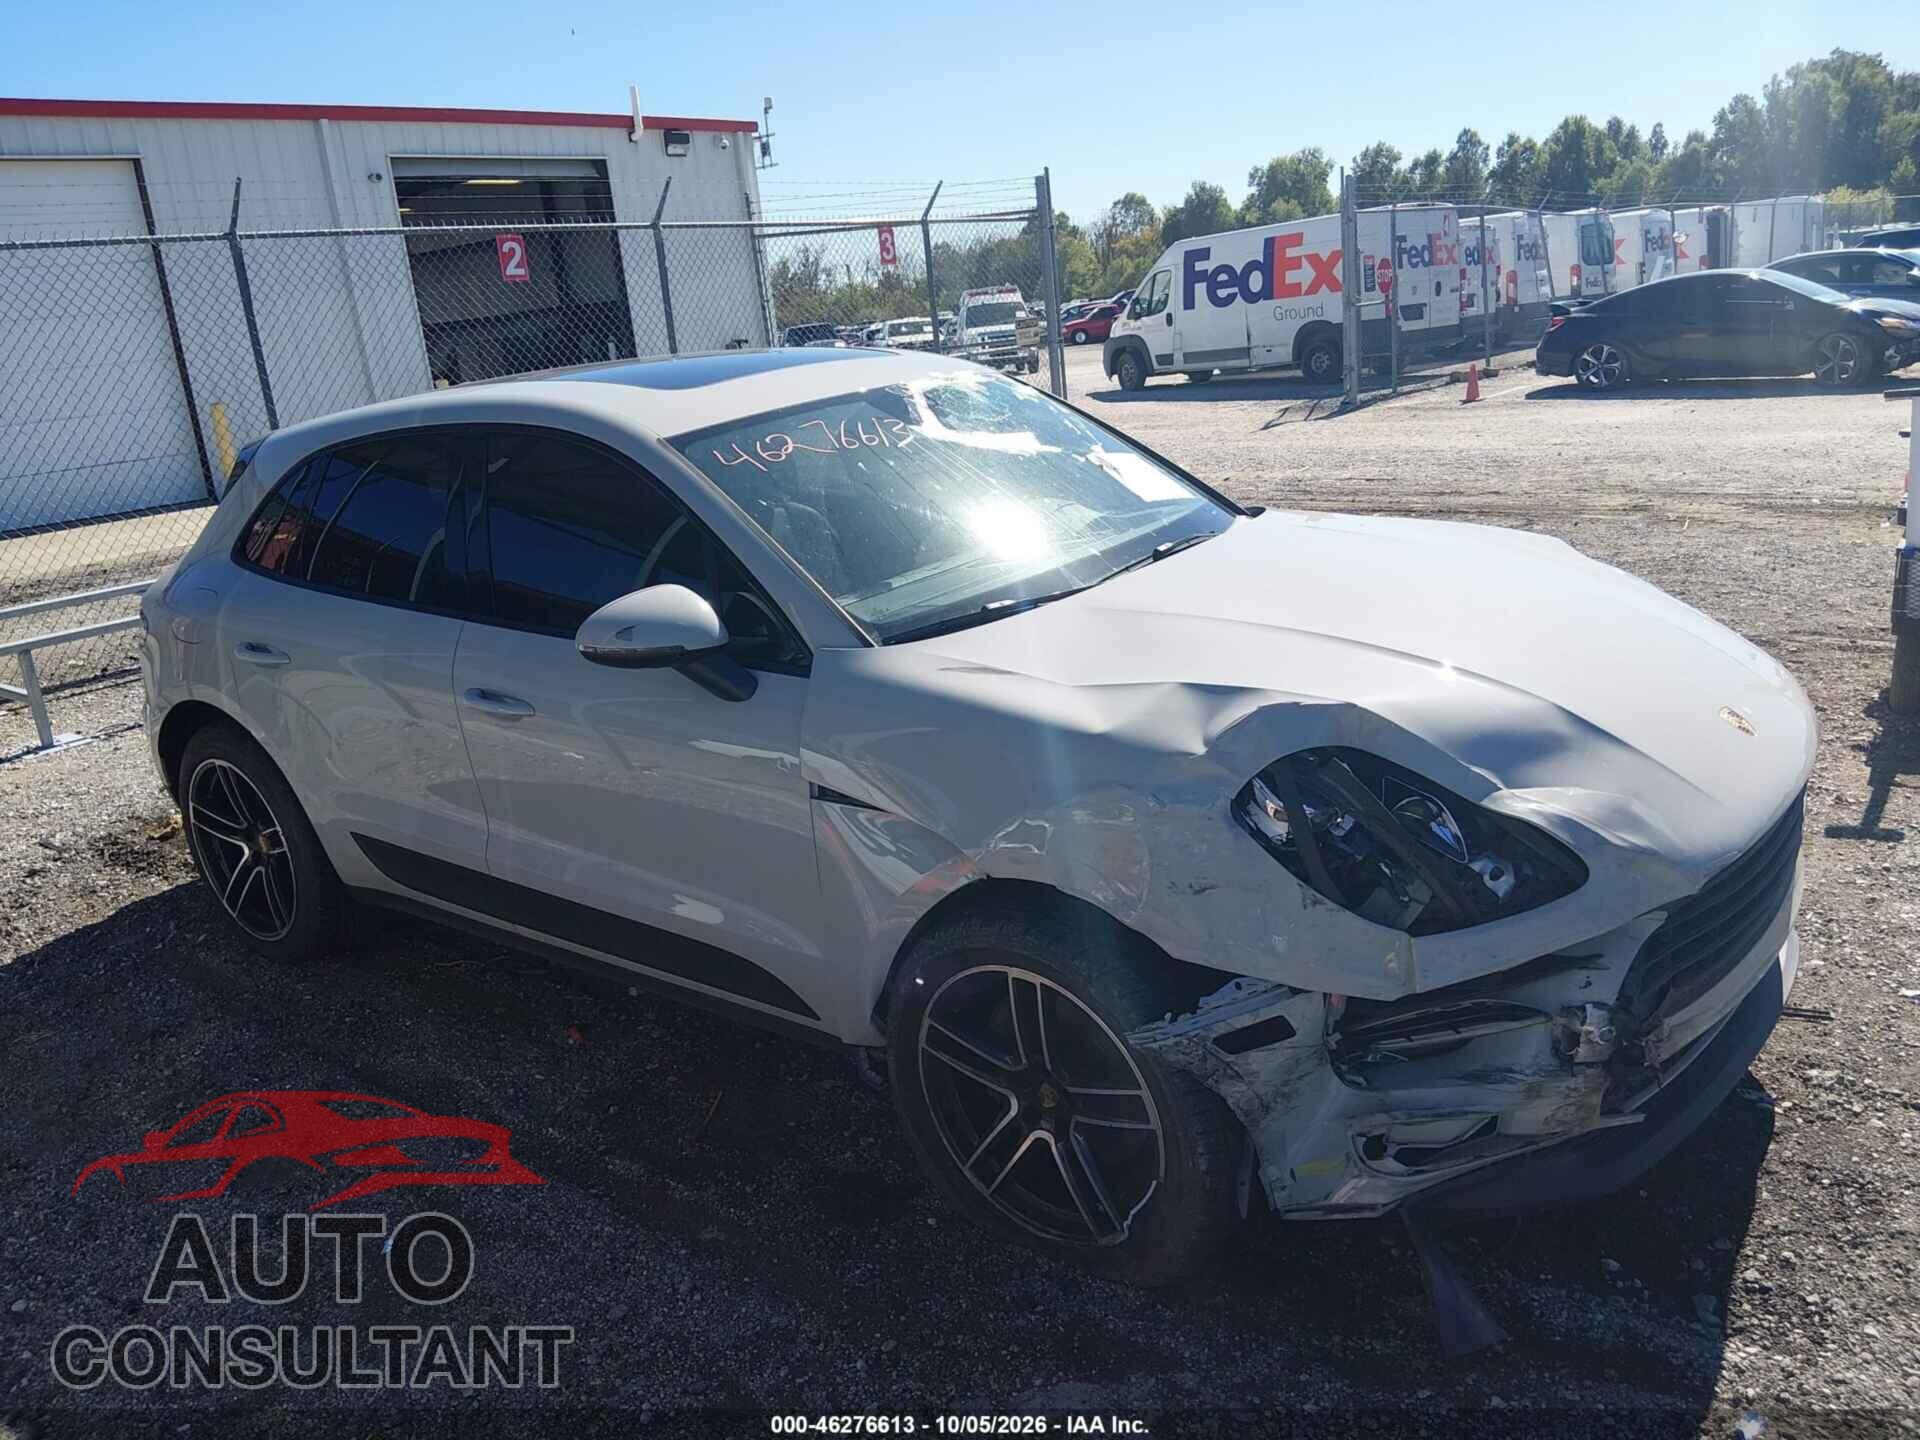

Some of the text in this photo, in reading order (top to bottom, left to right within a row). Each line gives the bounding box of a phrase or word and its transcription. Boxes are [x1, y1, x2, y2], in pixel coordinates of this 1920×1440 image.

[502, 241, 525, 275] 2
[881, 232, 895, 260] 3
[1396, 233, 1457, 269] FedEx
[1183, 232, 1343, 311] FedEx
[1273, 303, 1324, 322] Ground
[713, 418, 916, 472] 46276613
